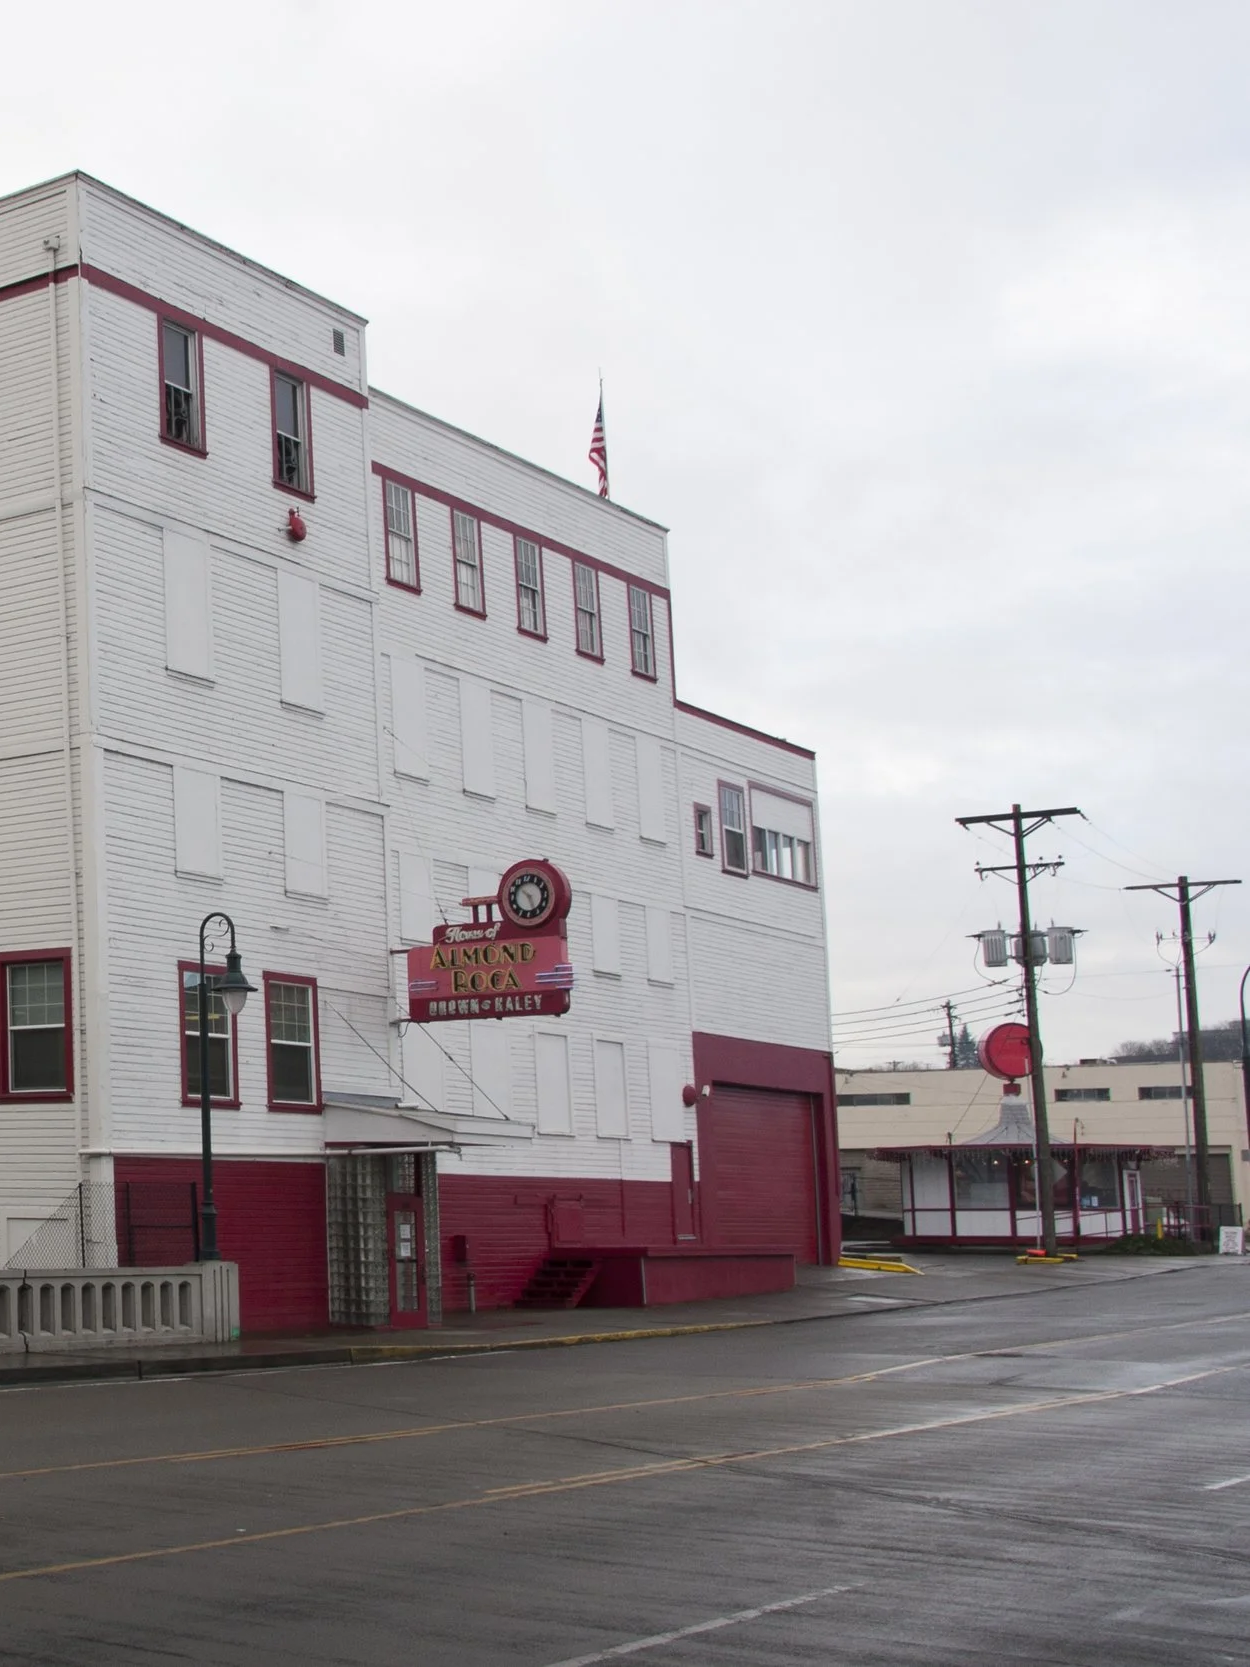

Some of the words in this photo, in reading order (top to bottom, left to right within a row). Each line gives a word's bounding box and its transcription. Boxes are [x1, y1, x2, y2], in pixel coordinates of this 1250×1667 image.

[444, 926, 484, 943] House
[485, 922, 501, 940] of
[430, 942, 536, 969] ALMOND
[452, 966, 522, 994] ROCA
[429, 999, 480, 1016] BROWN
[495, 995, 542, 1012] HALEY
